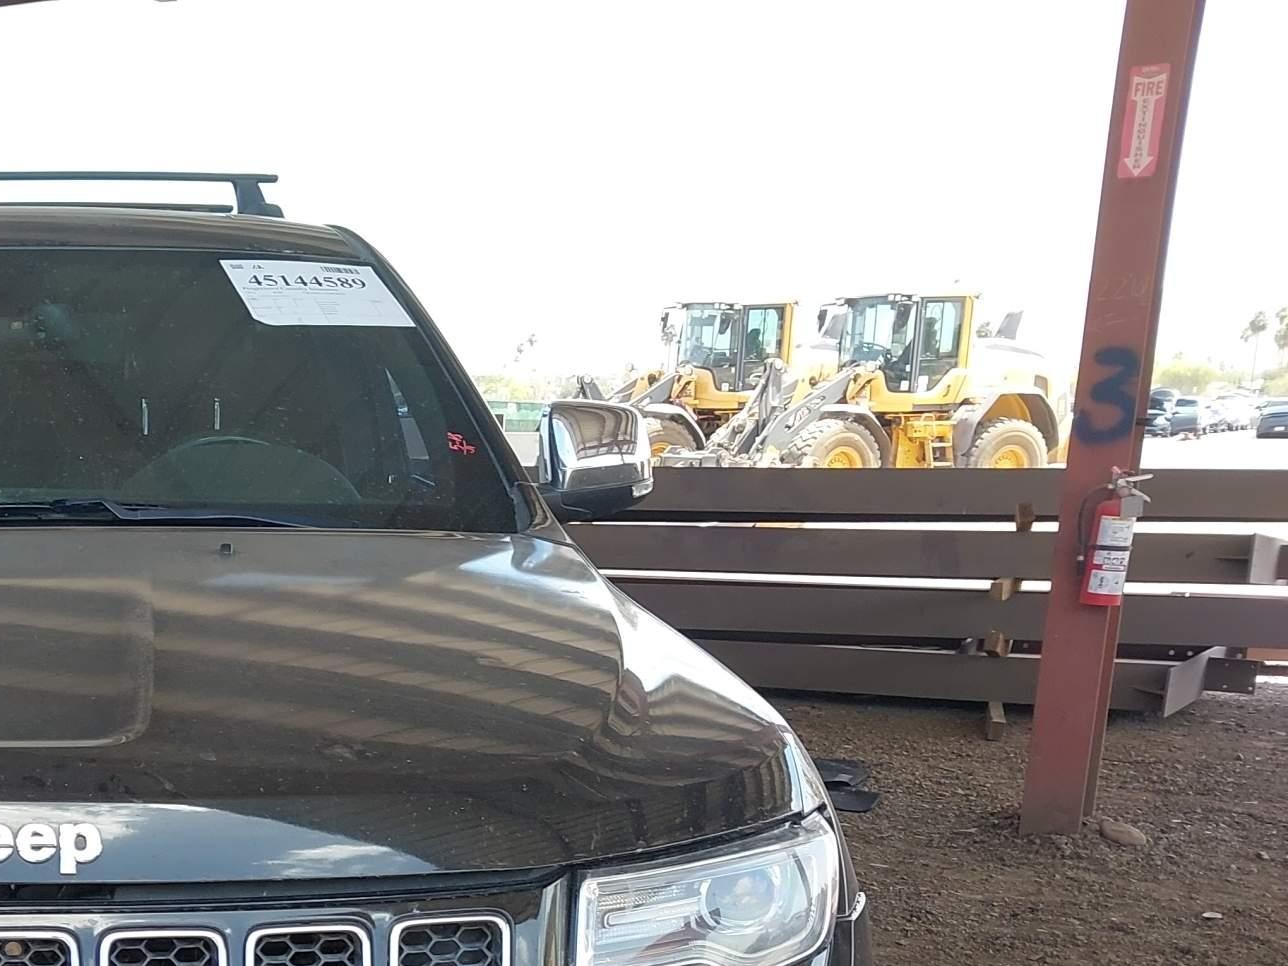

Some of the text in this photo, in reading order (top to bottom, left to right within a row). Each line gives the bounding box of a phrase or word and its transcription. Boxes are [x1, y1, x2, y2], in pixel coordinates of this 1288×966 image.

[1134, 80, 1164, 97] FIRE
[248, 274, 367, 289] 45144589
[1074, 346, 1140, 446] 3
